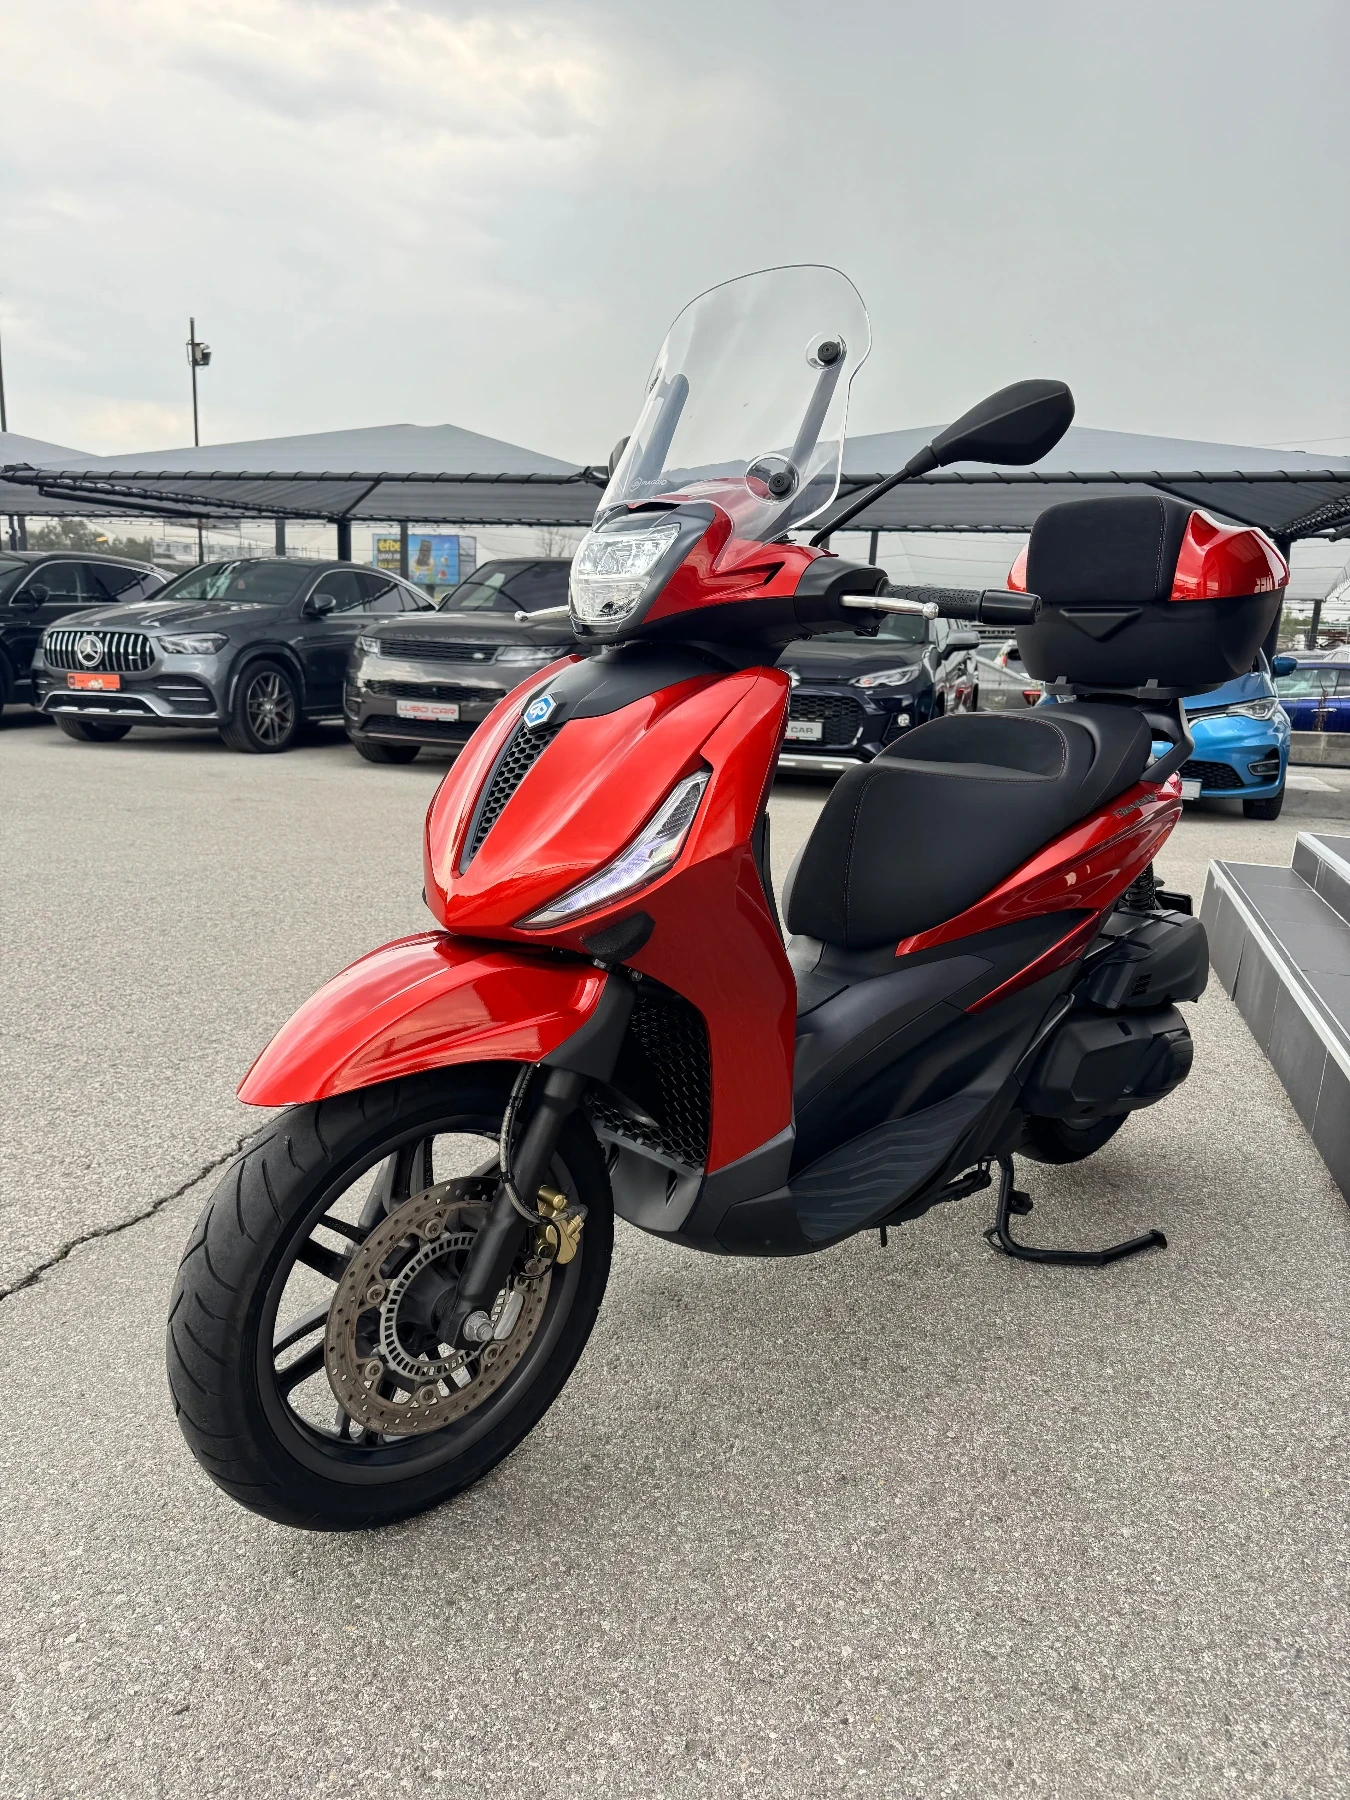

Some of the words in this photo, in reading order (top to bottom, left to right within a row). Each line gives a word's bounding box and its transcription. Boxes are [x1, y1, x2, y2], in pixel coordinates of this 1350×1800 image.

[399, 704, 429, 713] LUBO
[431, 706, 457, 715] CAR
[790, 726, 813, 734] CAR
